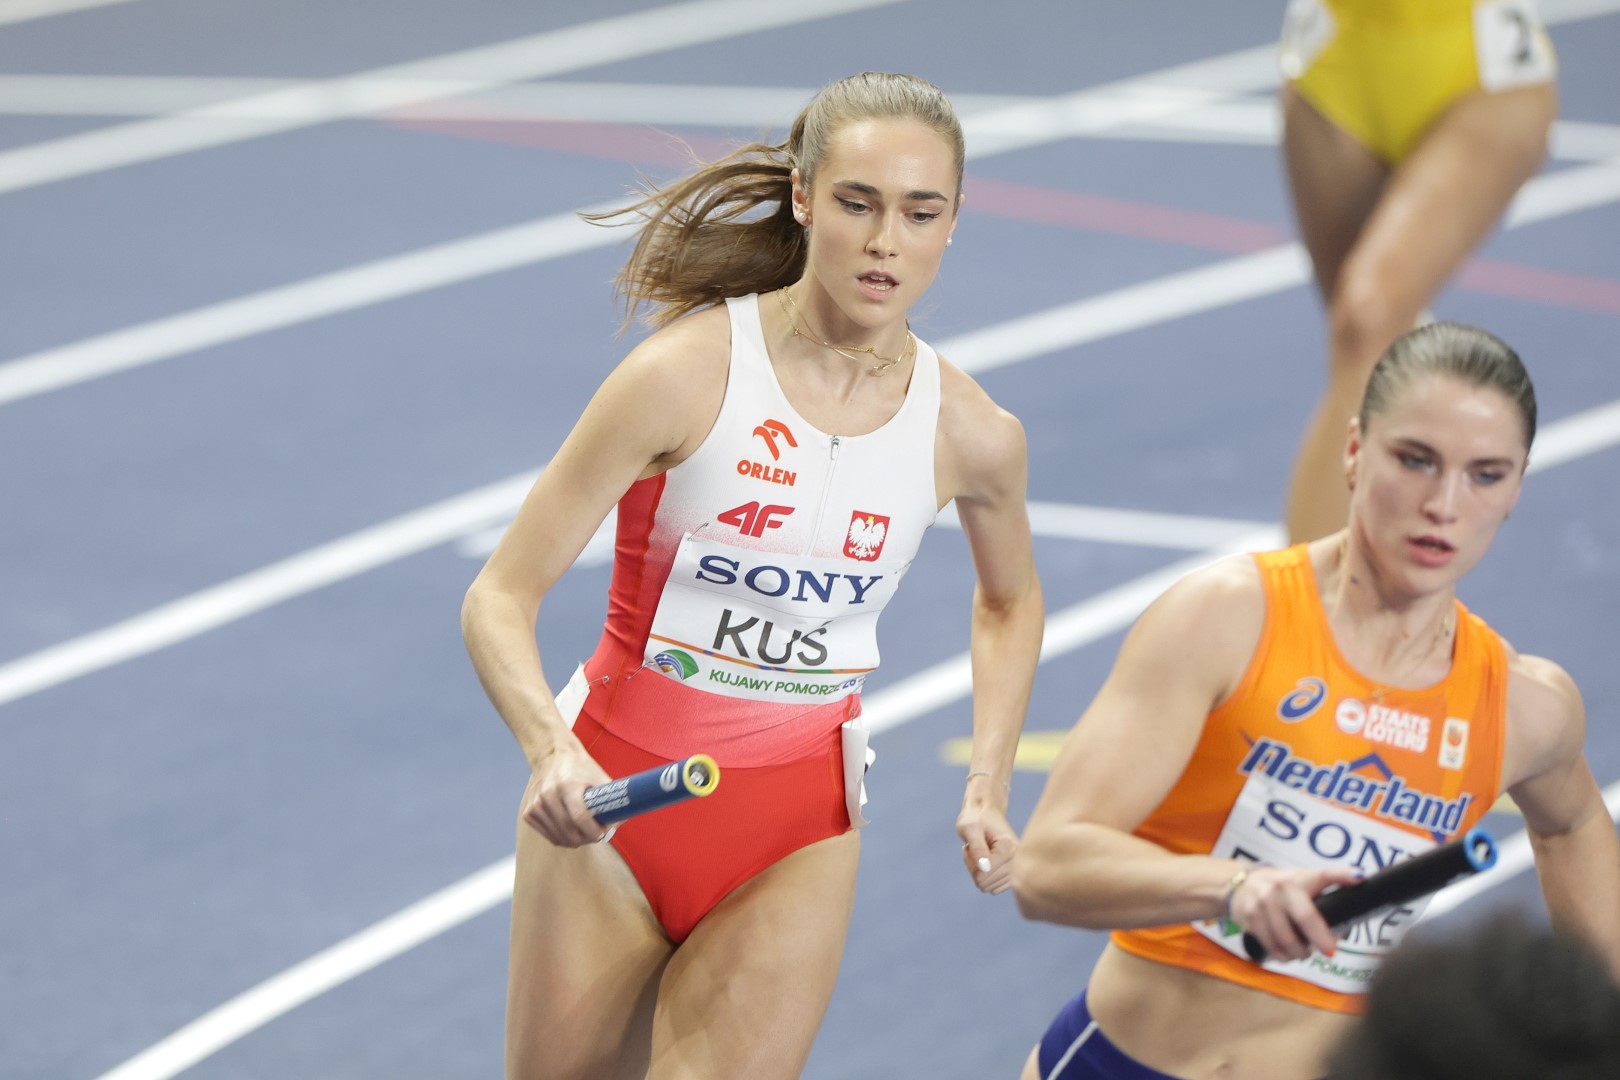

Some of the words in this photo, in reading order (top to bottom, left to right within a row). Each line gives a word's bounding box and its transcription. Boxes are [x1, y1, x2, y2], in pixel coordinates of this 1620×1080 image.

[736, 459, 797, 487] ORLEN
[716, 500, 796, 538] 4F
[695, 555, 883, 605] SONY
[712, 608, 833, 667] KUŚ
[709, 669, 773, 691] KUJAWY
[1368, 703, 1431, 735] STAATS
[1258, 800, 1421, 871] SON
